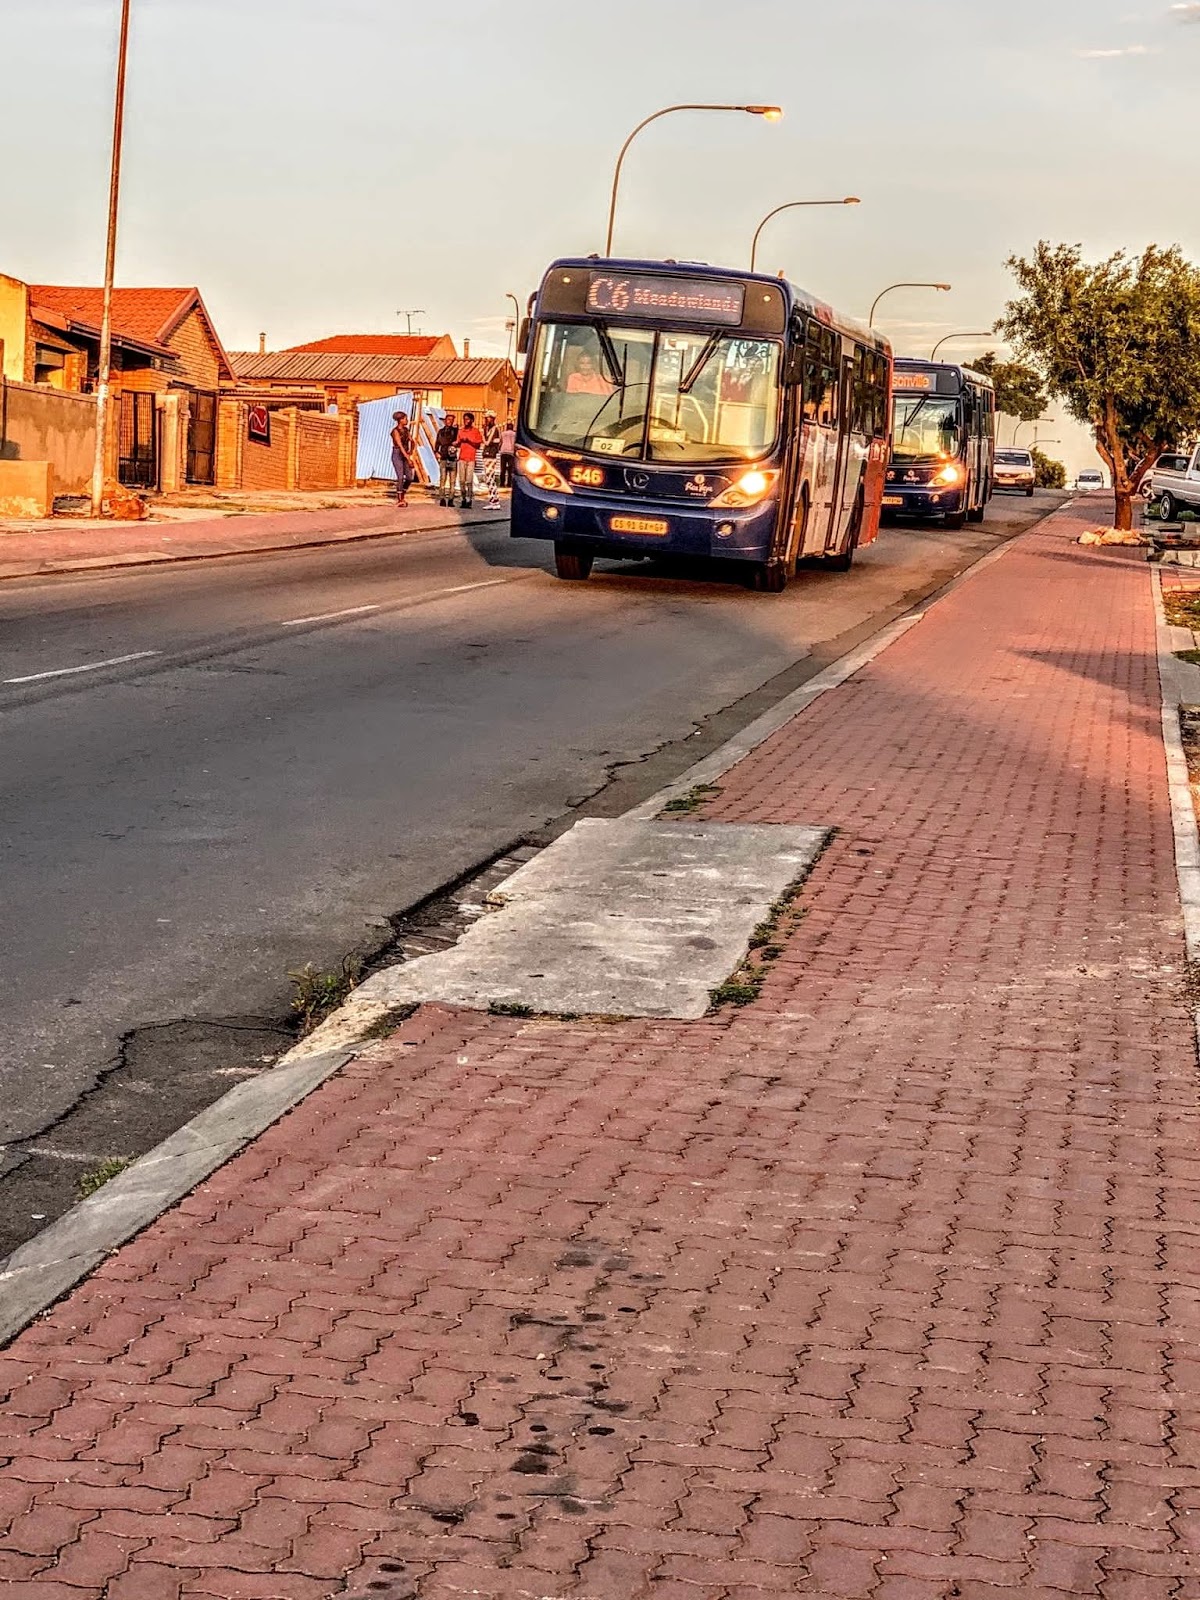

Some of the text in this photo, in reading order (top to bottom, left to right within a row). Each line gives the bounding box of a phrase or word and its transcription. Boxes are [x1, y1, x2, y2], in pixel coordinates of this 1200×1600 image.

[588, 278, 630, 311] C6
[600, 442, 613, 451] 02
[572, 466, 602, 485] 546
